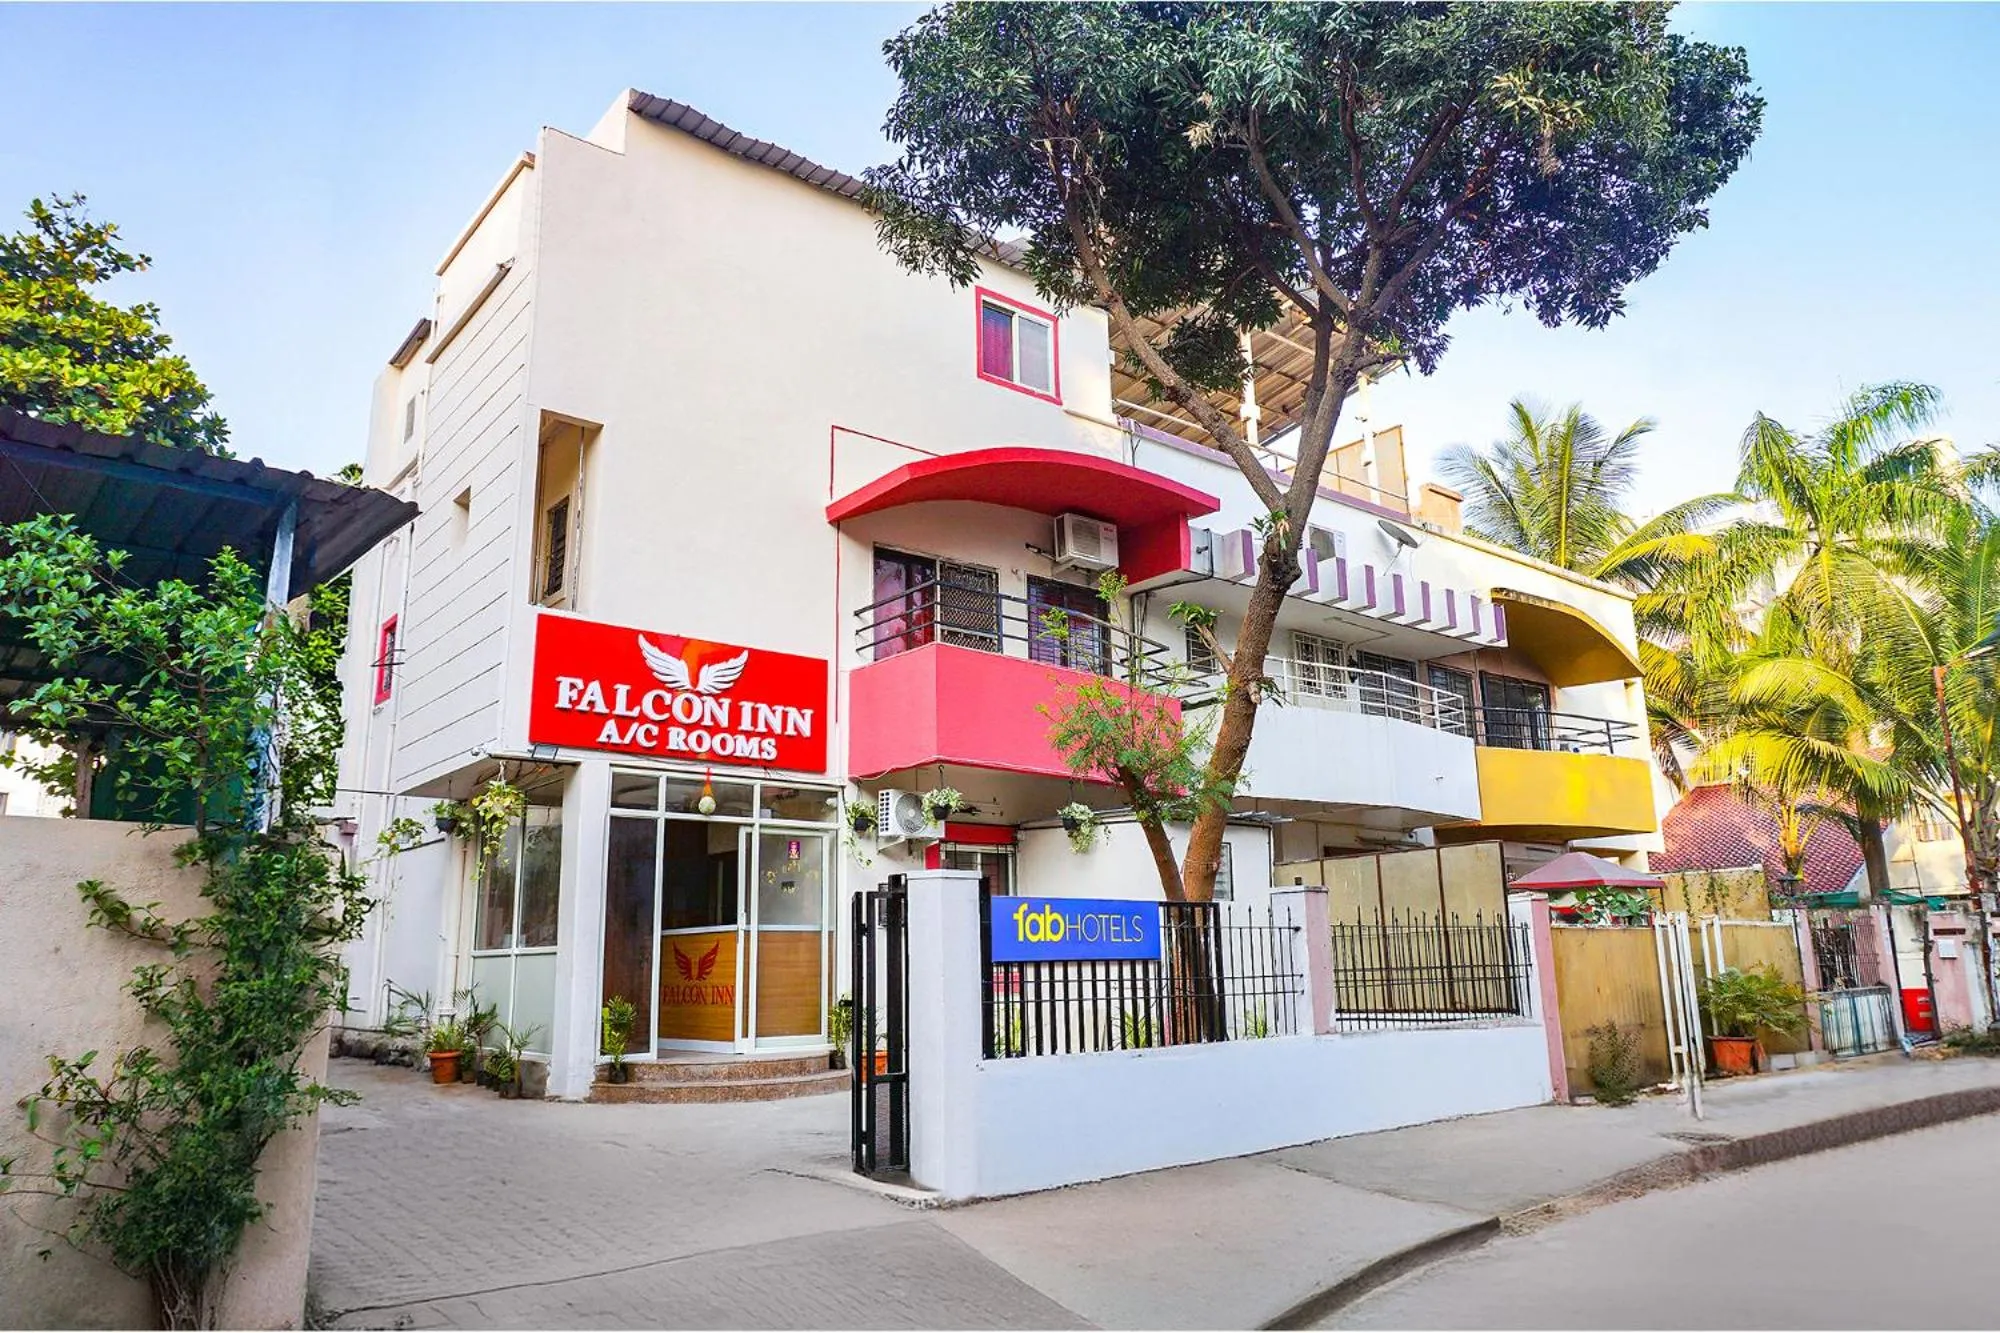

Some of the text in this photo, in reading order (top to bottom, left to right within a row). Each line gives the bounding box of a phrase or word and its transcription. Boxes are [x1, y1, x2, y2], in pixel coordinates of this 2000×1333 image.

[554, 675, 814, 738] FALCON INN
[597, 718, 779, 761] A/C ROOMS
[662, 984, 735, 1006] FALCON INN
